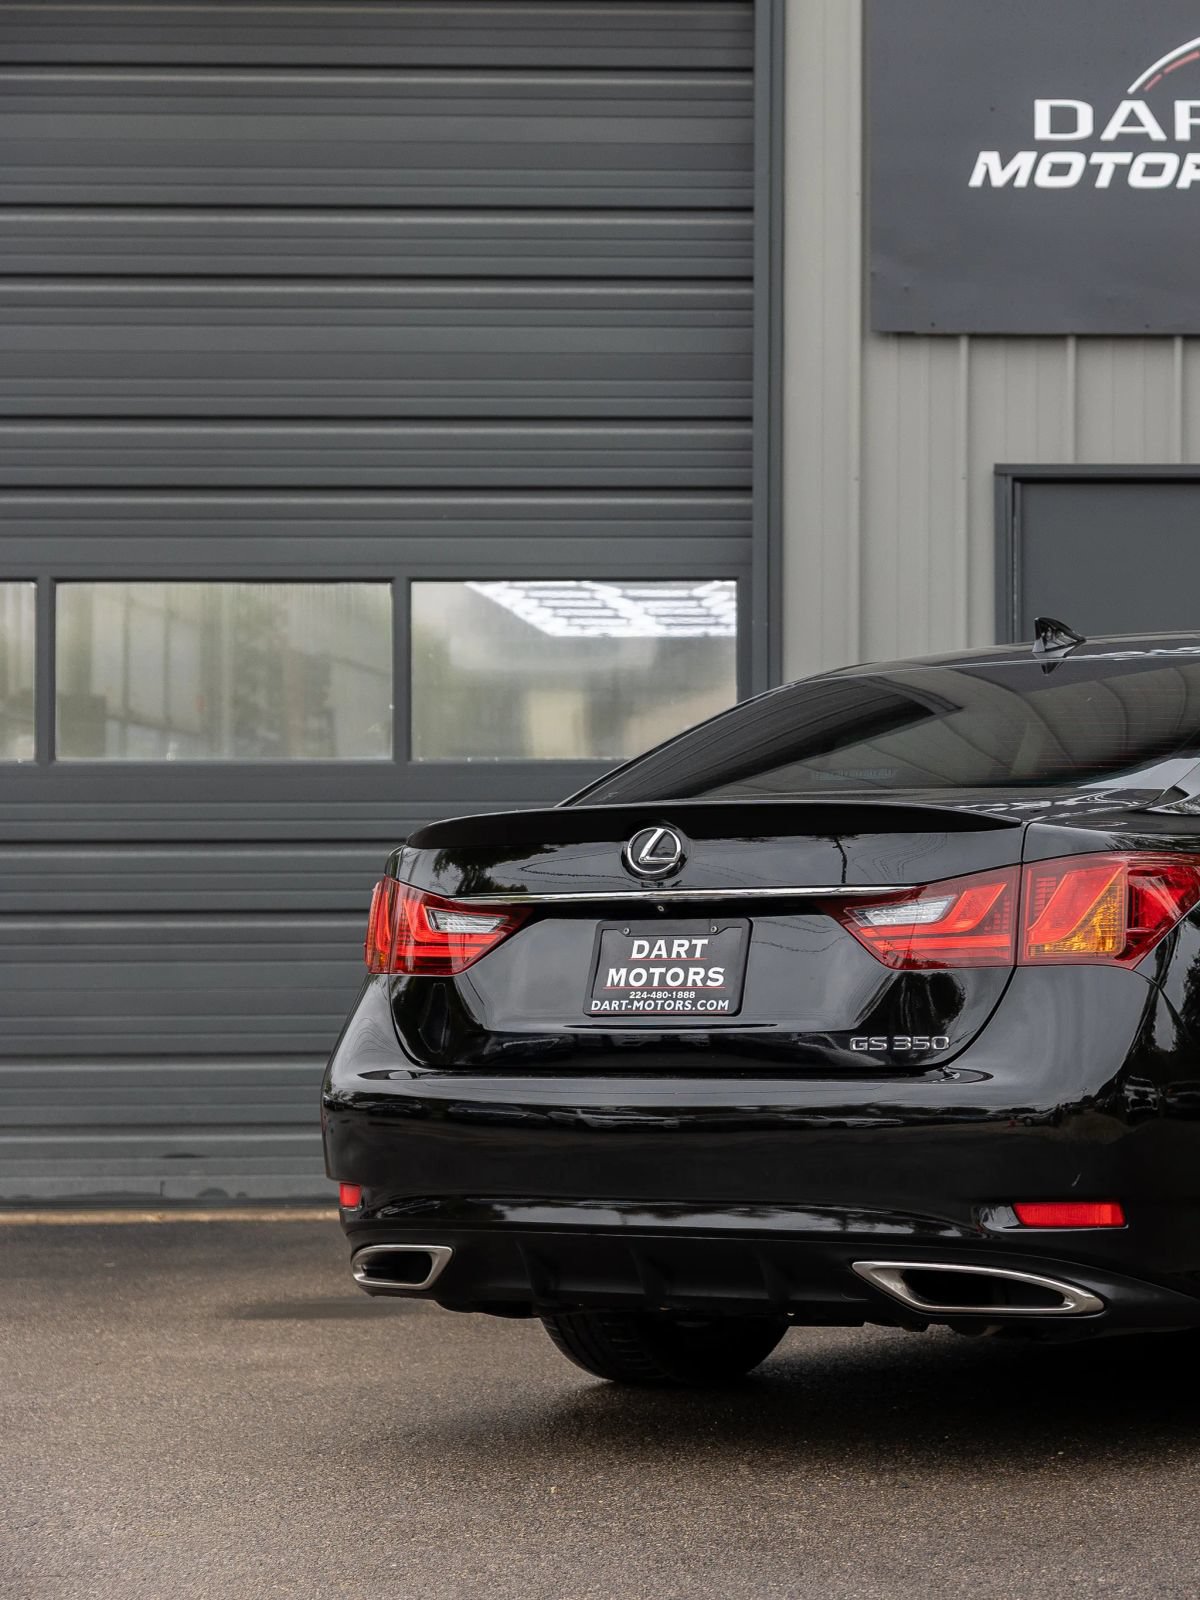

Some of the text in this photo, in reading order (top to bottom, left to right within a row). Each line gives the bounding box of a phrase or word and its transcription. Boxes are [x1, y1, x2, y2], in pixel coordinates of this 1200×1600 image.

[630, 938, 709, 959] DART
[606, 966, 726, 987] MOTORS
[629, 991, 696, 999] 224-480-1888
[591, 999, 729, 1011] DART-MOTORS.COM
[849, 1036, 950, 1051] GS 350
